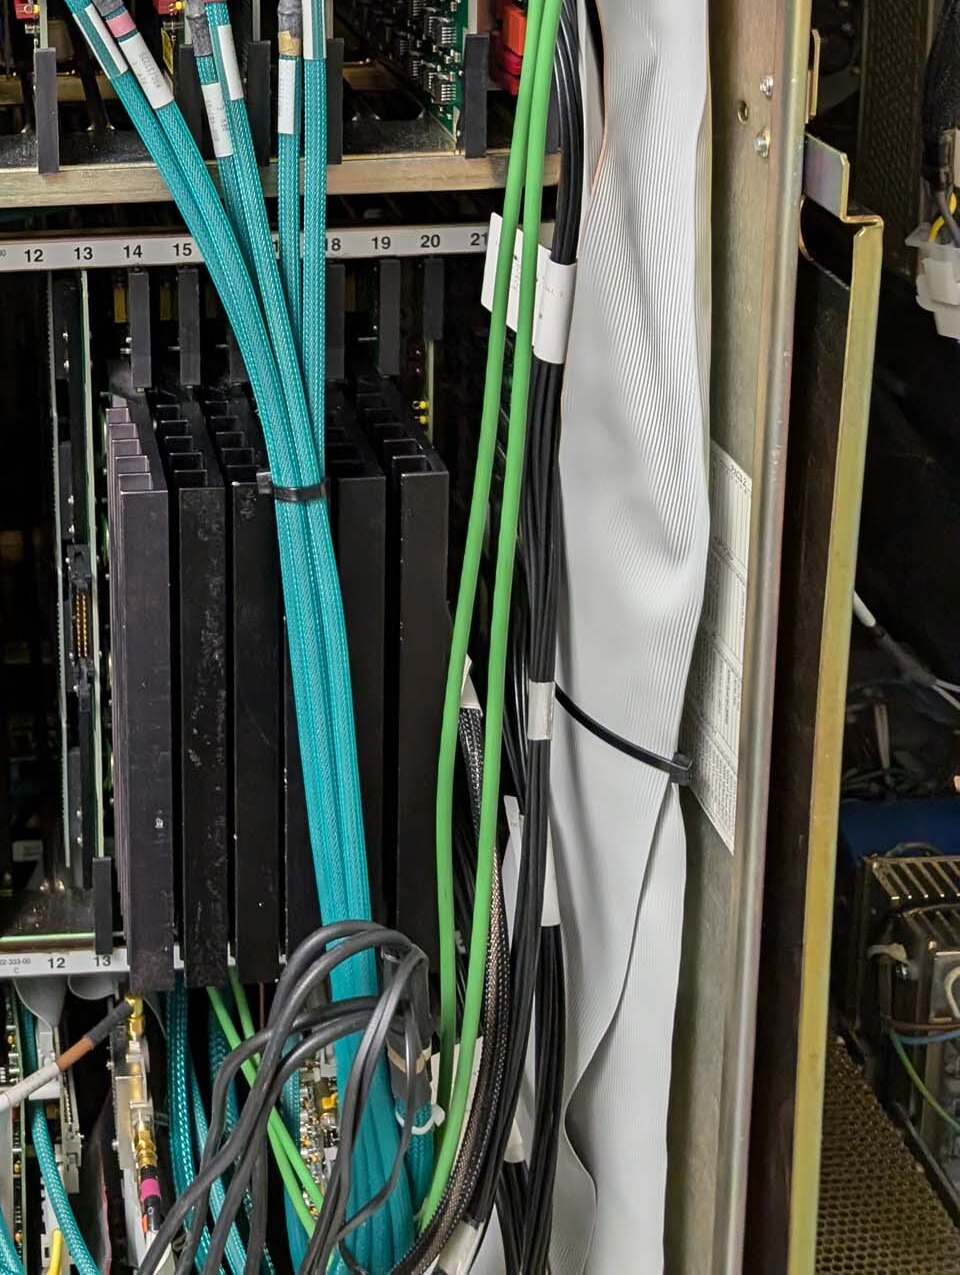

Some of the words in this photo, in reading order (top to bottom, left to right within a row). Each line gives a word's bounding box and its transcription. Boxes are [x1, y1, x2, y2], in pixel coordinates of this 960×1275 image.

[24, 249, 44, 263] 12
[73, 247, 93, 261] 13
[123, 245, 143, 259] 14
[172, 243, 192, 257] 15
[371, 237, 391, 250] 19
[420, 235, 441, 248] 20
[470, 233, 487, 246] 21
[47, 958, 66, 969] 12
[95, 955, 111, 967] 13
